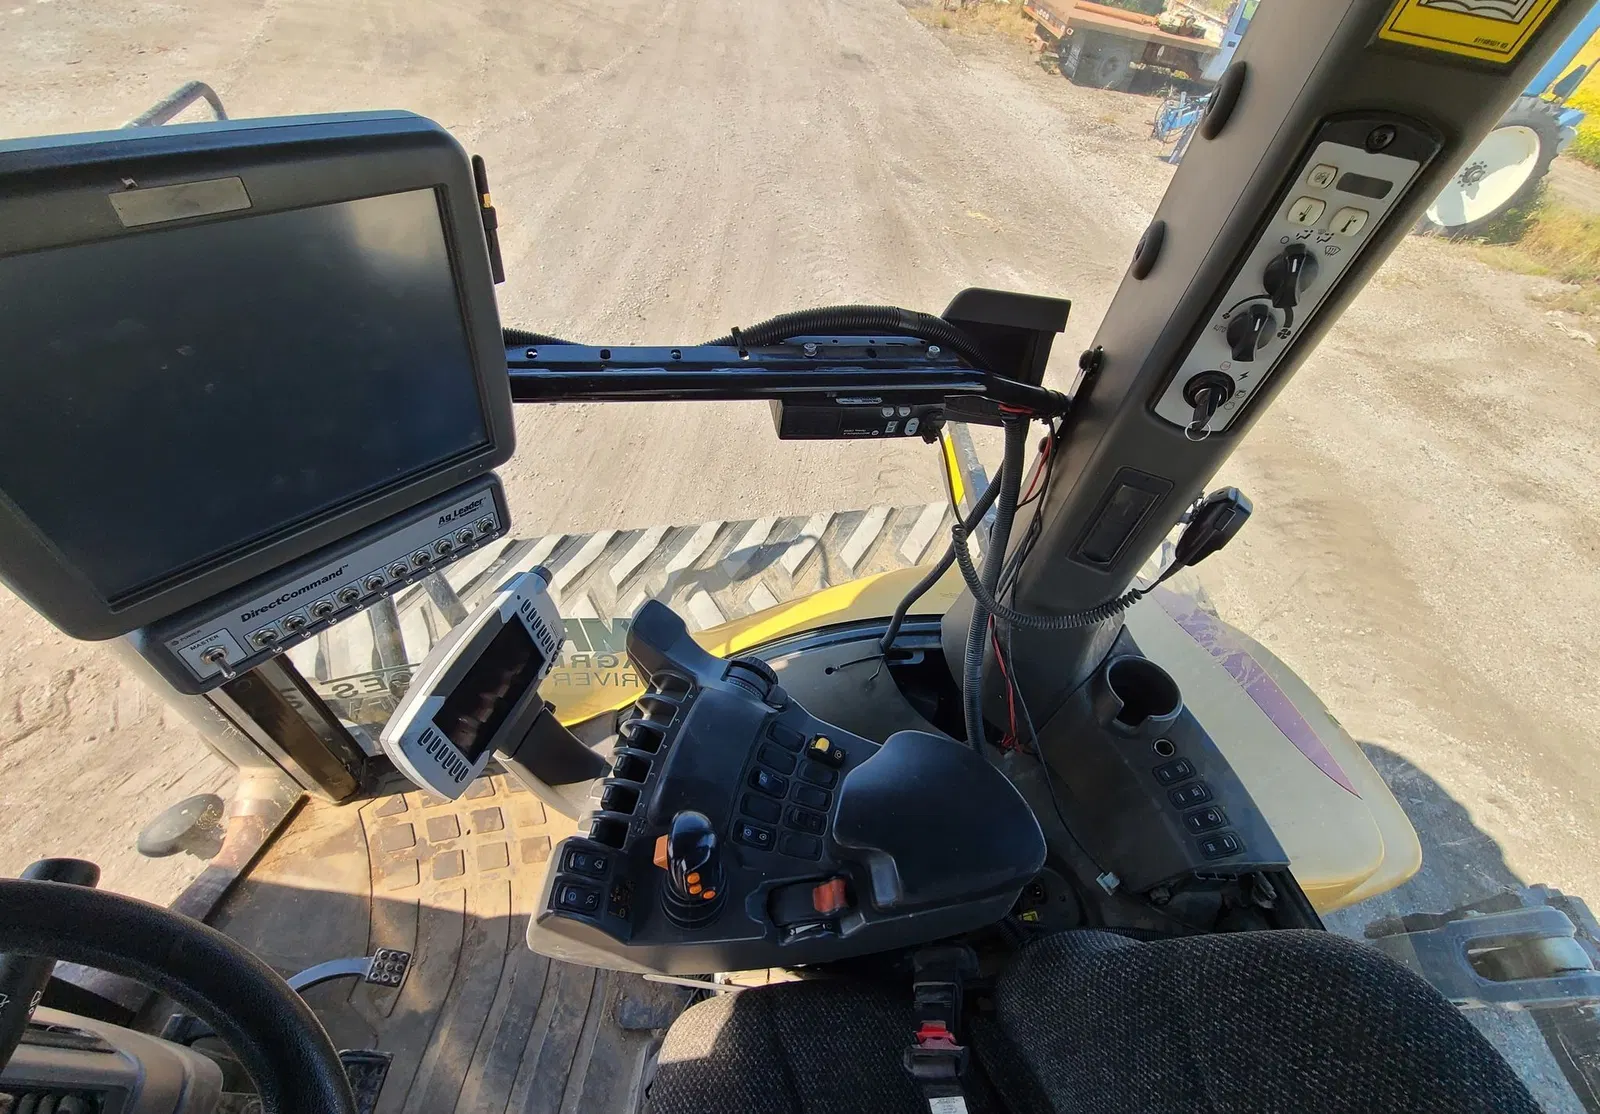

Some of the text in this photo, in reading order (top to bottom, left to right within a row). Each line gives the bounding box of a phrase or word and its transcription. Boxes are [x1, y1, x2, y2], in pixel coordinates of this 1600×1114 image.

[1213, 324, 1226, 333] AUTO
[438, 512, 452, 526] Ag
[453, 498, 484, 517] Leader
[190, 634, 219, 651] MASTER
